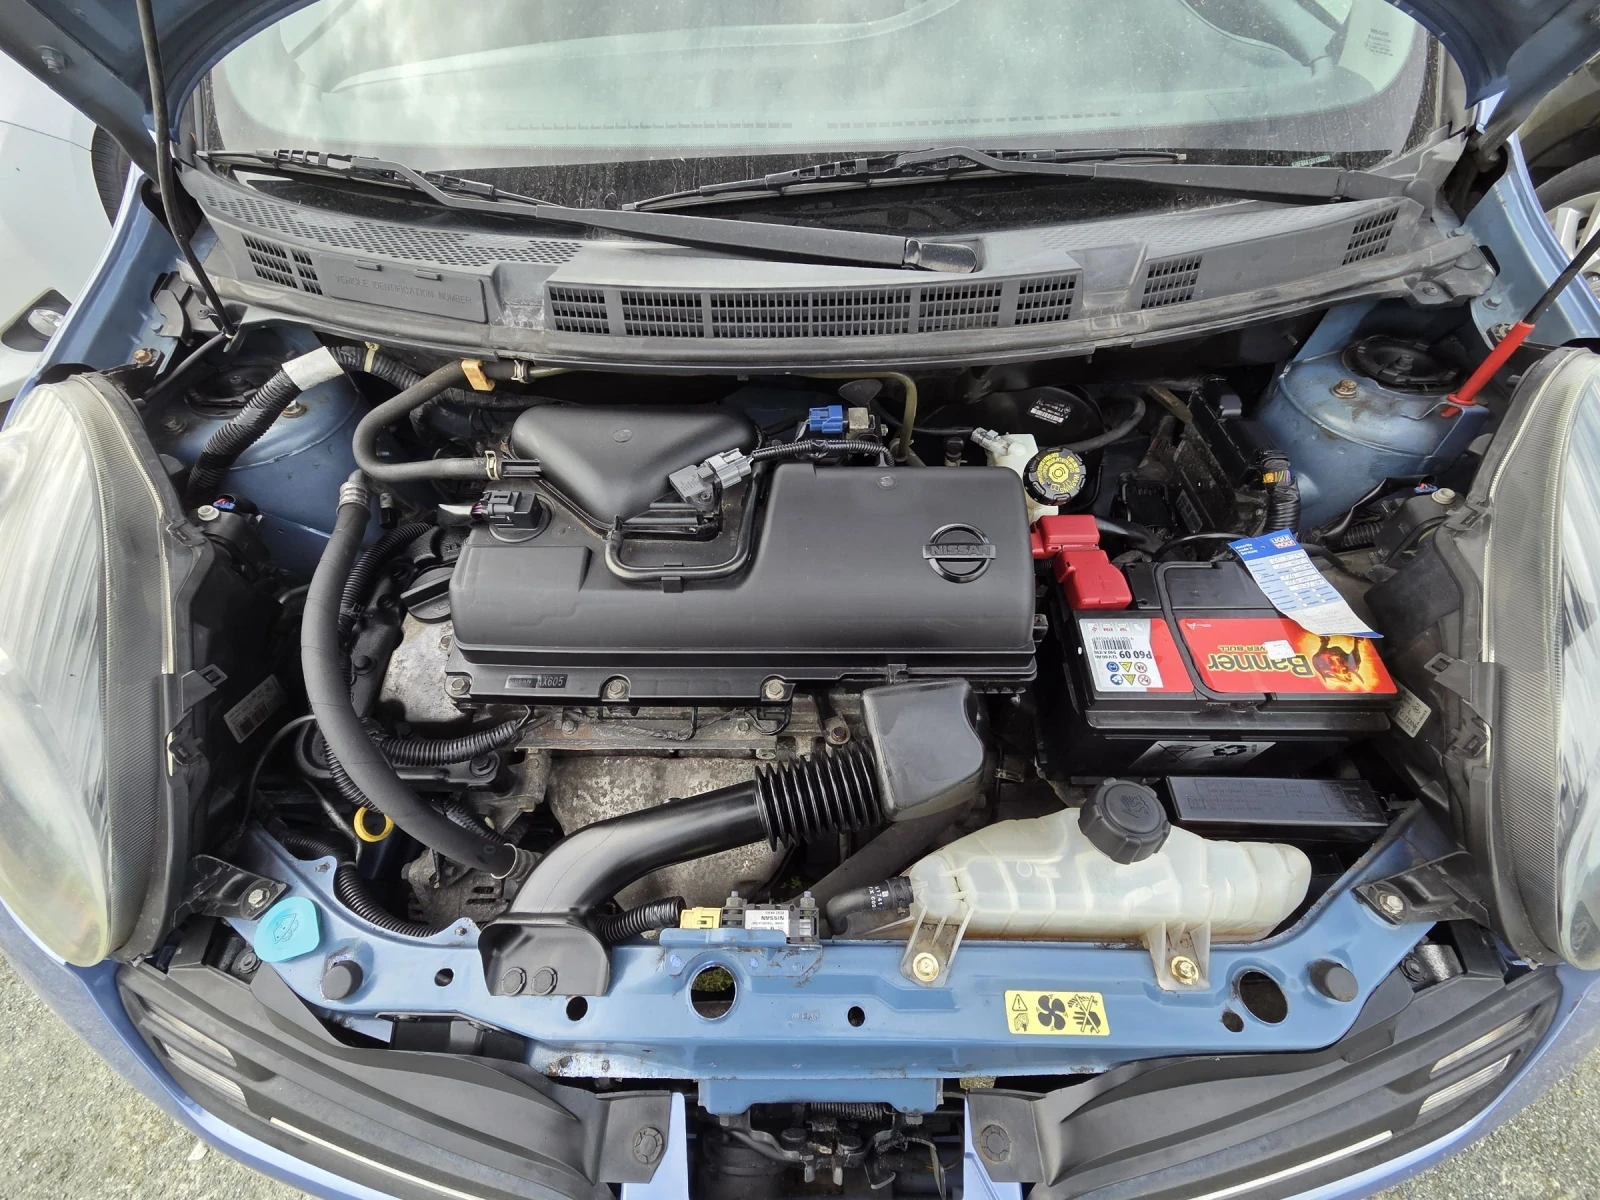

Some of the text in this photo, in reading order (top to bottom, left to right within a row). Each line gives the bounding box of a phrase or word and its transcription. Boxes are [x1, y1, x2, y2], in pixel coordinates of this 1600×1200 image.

[335, 274, 472, 305] VEHICLE IDENTIFICATION NUMBER
[930, 545, 991, 556] NISSAN
[1119, 650, 1152, 660] P60 09
[1208, 654, 1314, 676] Banner
